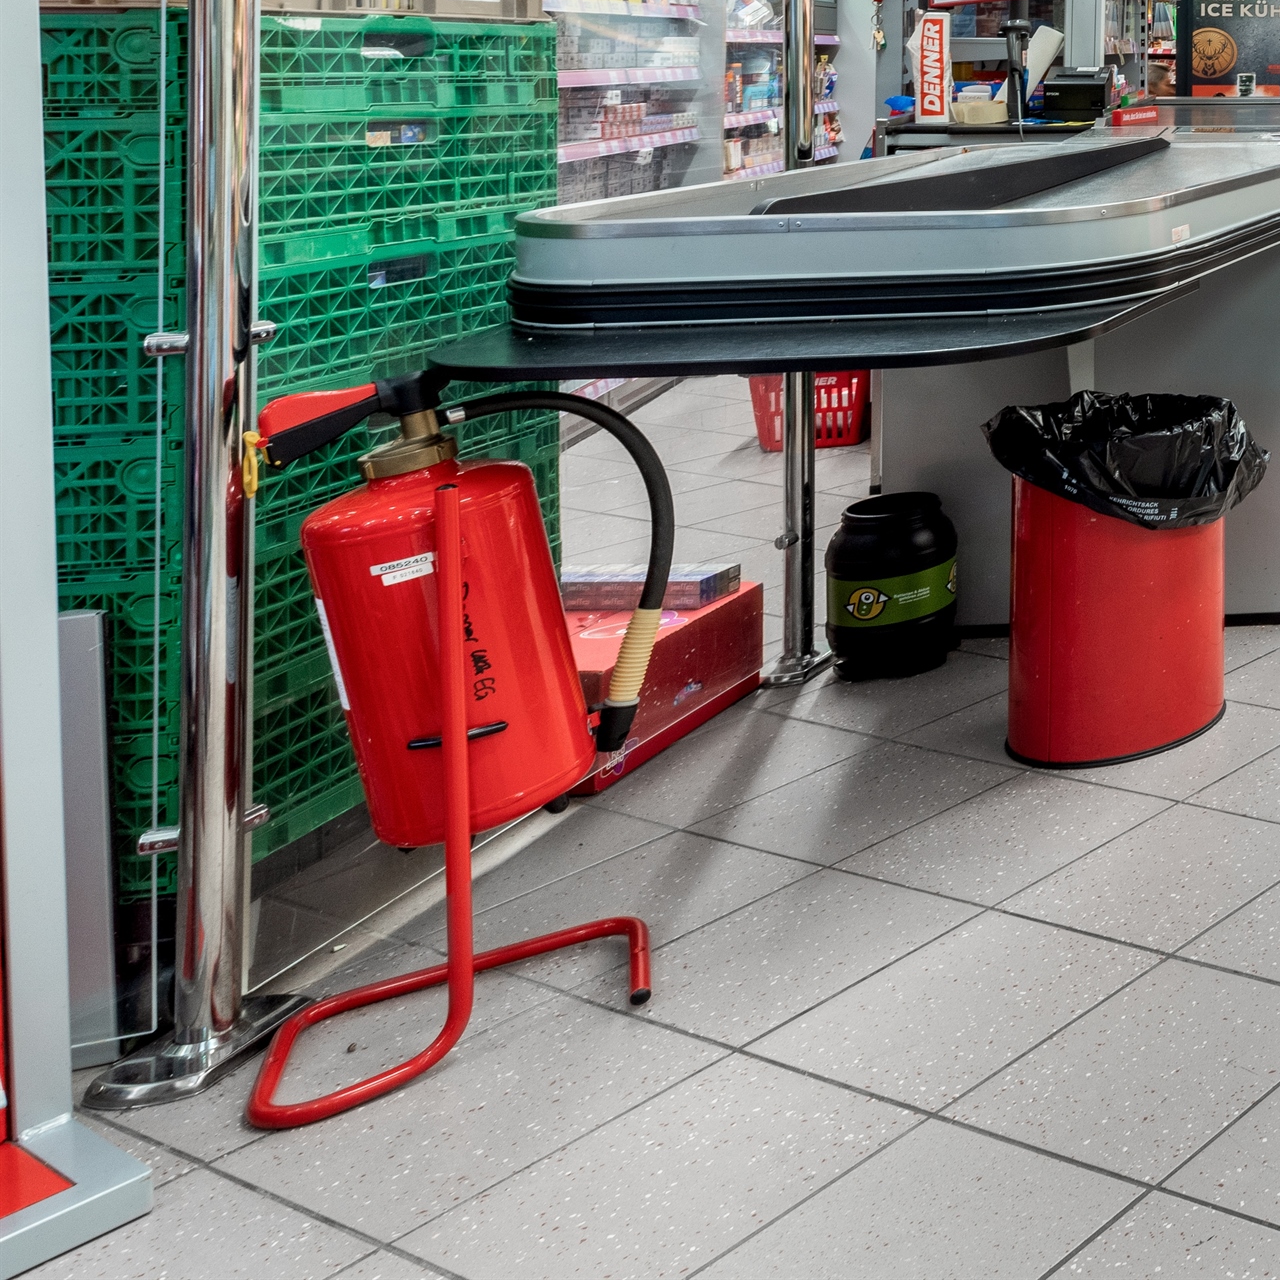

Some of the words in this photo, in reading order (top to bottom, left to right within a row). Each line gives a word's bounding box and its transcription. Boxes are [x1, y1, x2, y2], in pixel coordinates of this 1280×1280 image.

[1201, 3, 1233, 17] ICE
[923, 22, 941, 112] DENNER
[379, 556, 428, 572] 085240
